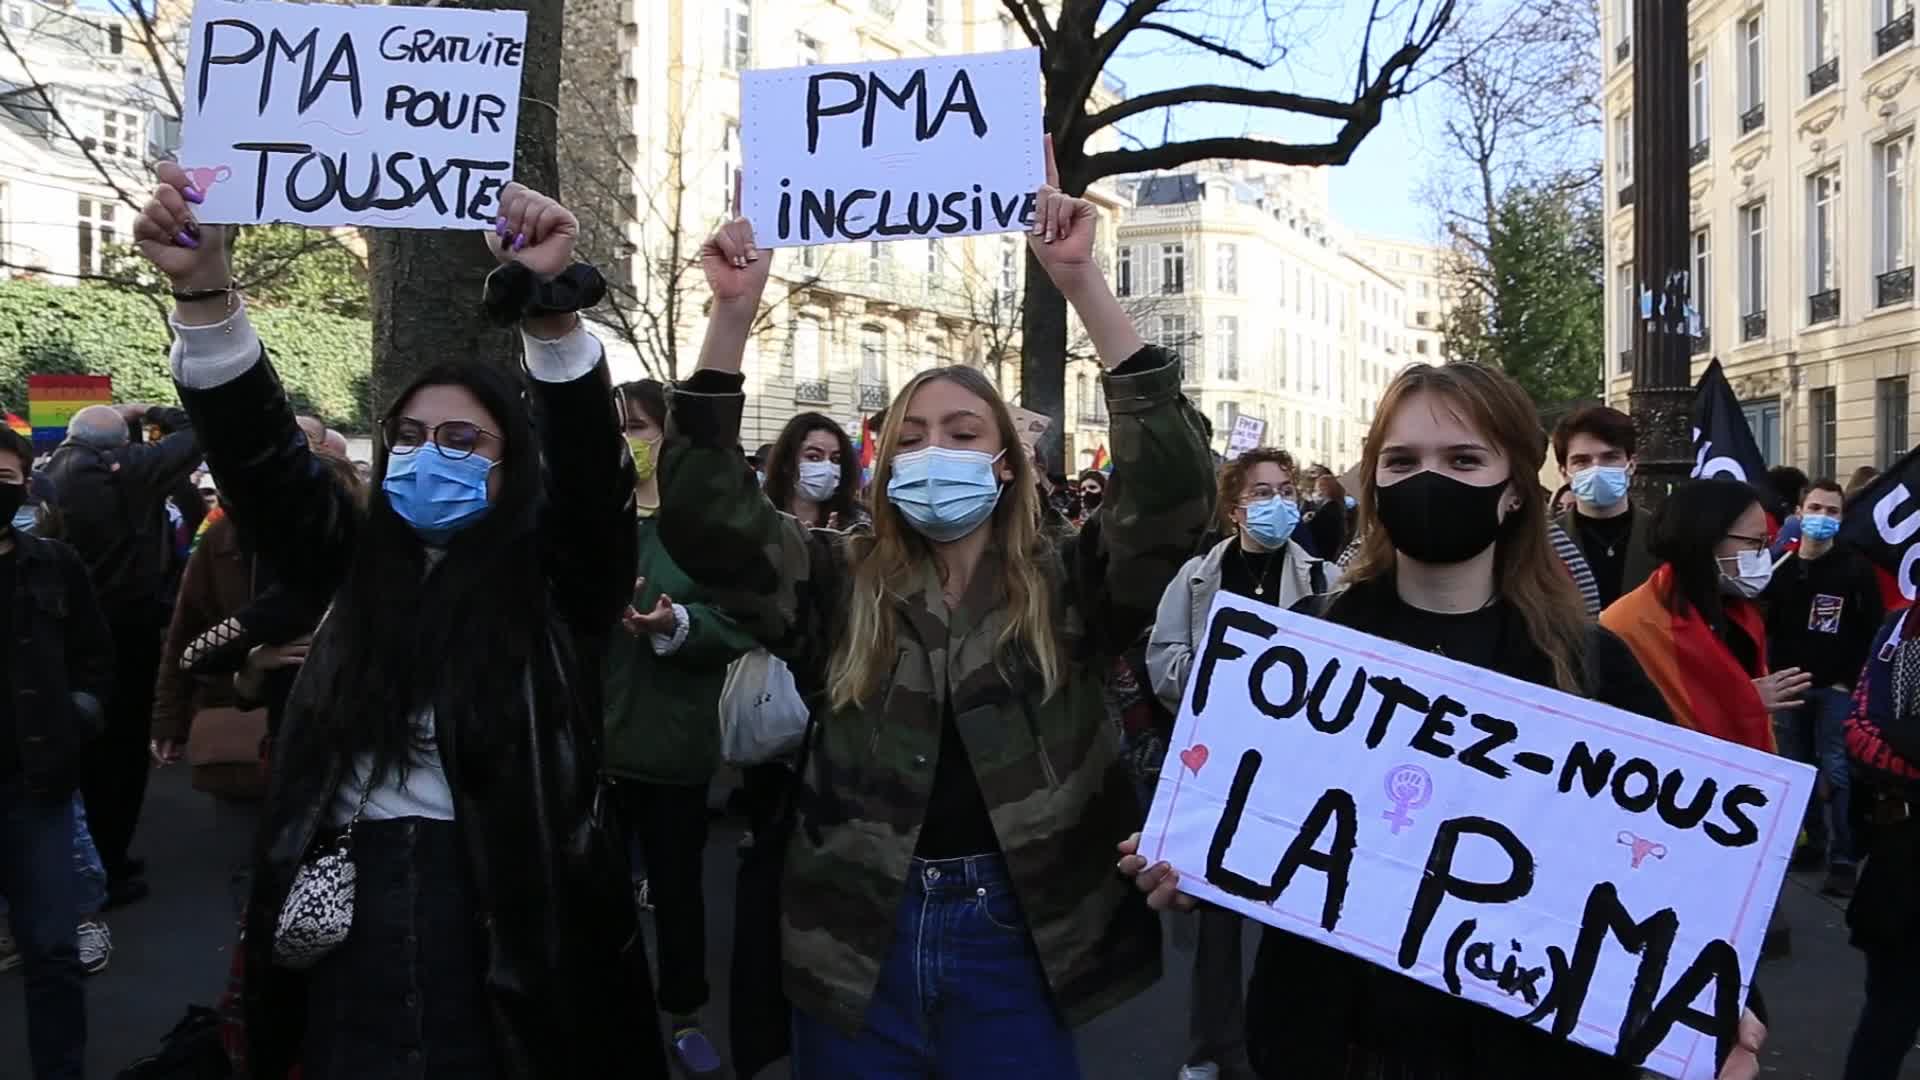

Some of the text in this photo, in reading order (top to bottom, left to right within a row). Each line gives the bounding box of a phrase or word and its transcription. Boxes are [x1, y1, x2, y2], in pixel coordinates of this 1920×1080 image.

[198, 19, 363, 118] PMA
[385, 84, 506, 134] POUR
[806, 68, 986, 153] PMA
[233, 142, 514, 224] TOUSXTE
[1192, 607, 1769, 848] FOUTEZ-NOUS
[1205, 749, 1358, 931] LA
